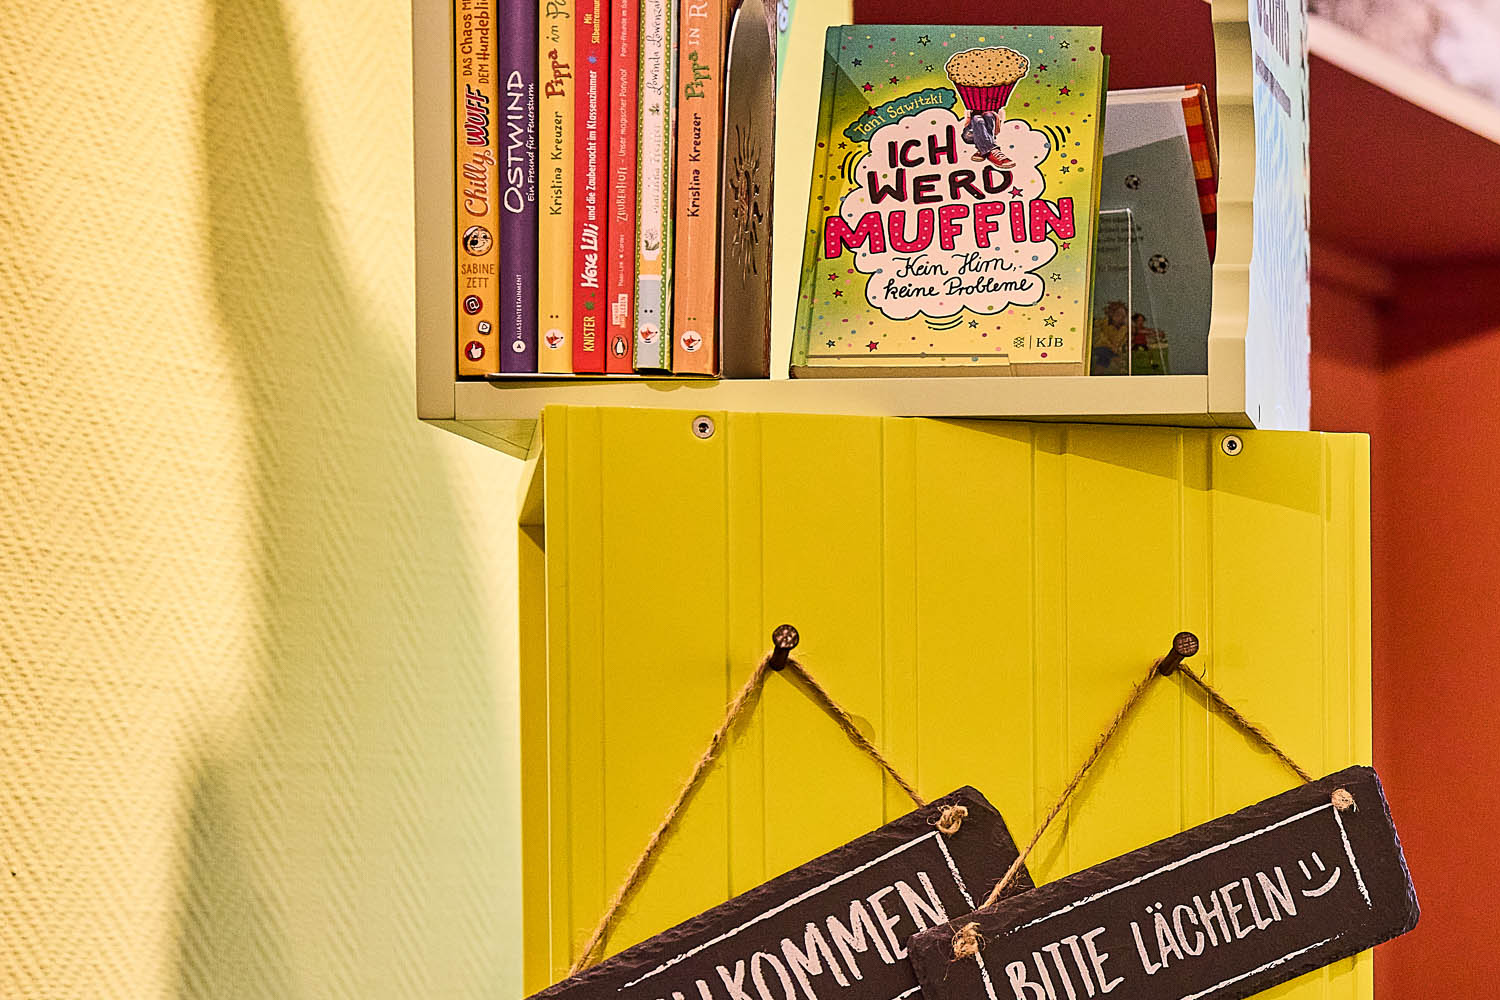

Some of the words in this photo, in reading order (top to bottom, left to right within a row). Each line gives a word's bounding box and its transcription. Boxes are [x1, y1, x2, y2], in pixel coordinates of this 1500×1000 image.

[460, 14, 472, 54] Chaos
[474, 0, 490, 60] Hundebli
[546, 25, 560, 43] in
[584, 13, 593, 25] Mit
[463, 57, 472, 76] DAS
[478, 64, 489, 84] DEM
[545, 48, 572, 99] Pippa
[684, 50, 712, 100] Pippa
[527, 82, 536, 133] Feuersturm
[586, 70, 597, 129] Klassenzimmer
[853, 116, 886, 136] Tani
[888, 93, 943, 119] Sawitzki
[503, 70, 525, 214] OSTWIND
[526, 134, 536, 149] für
[551, 111, 563, 160] Kreuzer
[586, 131, 597, 141] im
[688, 112, 702, 162] Kreuzer
[888, 125, 958, 168] ICH
[463, 150, 496, 217] Chilly
[527, 152, 535, 184] Freund
[586, 142, 597, 191] Zaubernacht
[867, 165, 1014, 204] WERD
[527, 185, 535, 202] Ein
[549, 168, 563, 216] Kristina
[586, 192, 596, 205] die
[687, 169, 701, 218] Kristina
[586, 205, 596, 220] und
[824, 197, 1076, 259] MUFFIN
[580, 223, 599, 251] Lilli
[461, 263, 495, 275] SABINE
[466, 277, 489, 289] ZETT
[580, 253, 599, 289] Hexe
[892, 254, 948, 278] Kein
[952, 252, 1017, 275] Hirn,
[883, 278, 940, 300] keine
[943, 277, 1033, 296] Probleme
[583, 316, 596, 352] KNISTER
[1036, 337, 1064, 348] KJB
[1131, 865, 1299, 975] LÄCHELN
